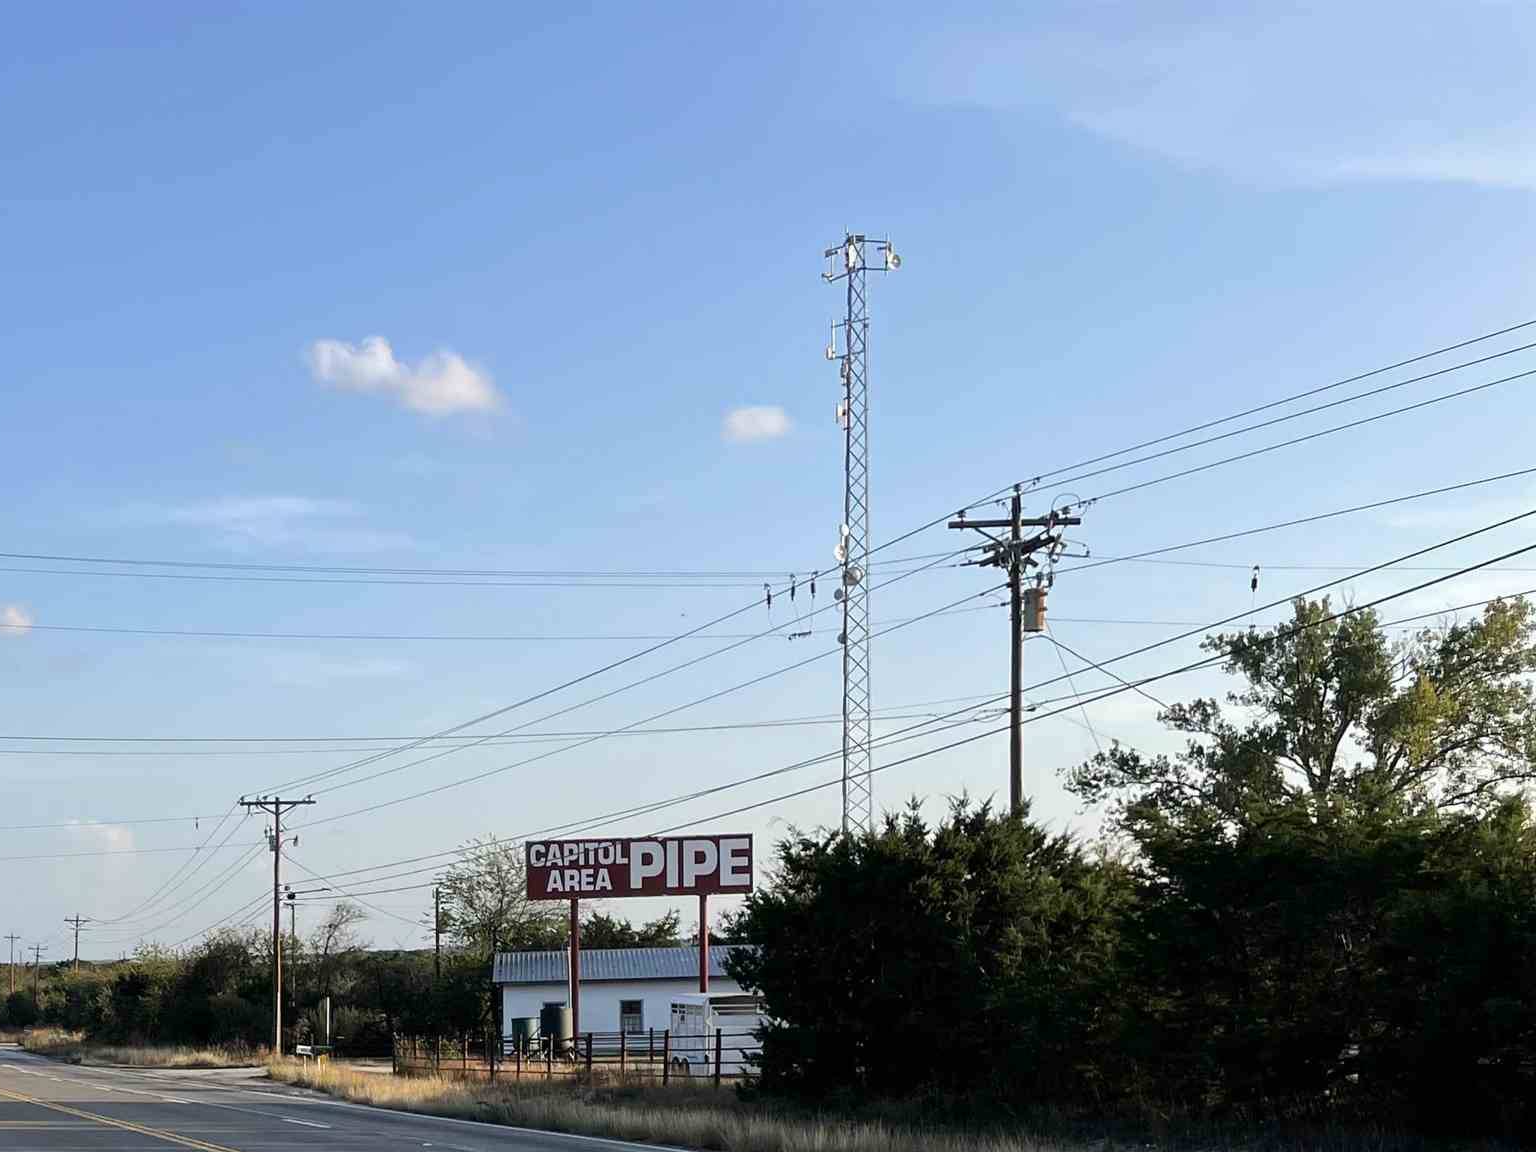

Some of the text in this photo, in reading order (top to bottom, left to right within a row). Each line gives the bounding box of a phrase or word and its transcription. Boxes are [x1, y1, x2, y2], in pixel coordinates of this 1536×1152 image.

[530, 842, 629, 867] CAPITOL
[630, 838, 750, 889] PIPE
[546, 868, 612, 892] AREA
